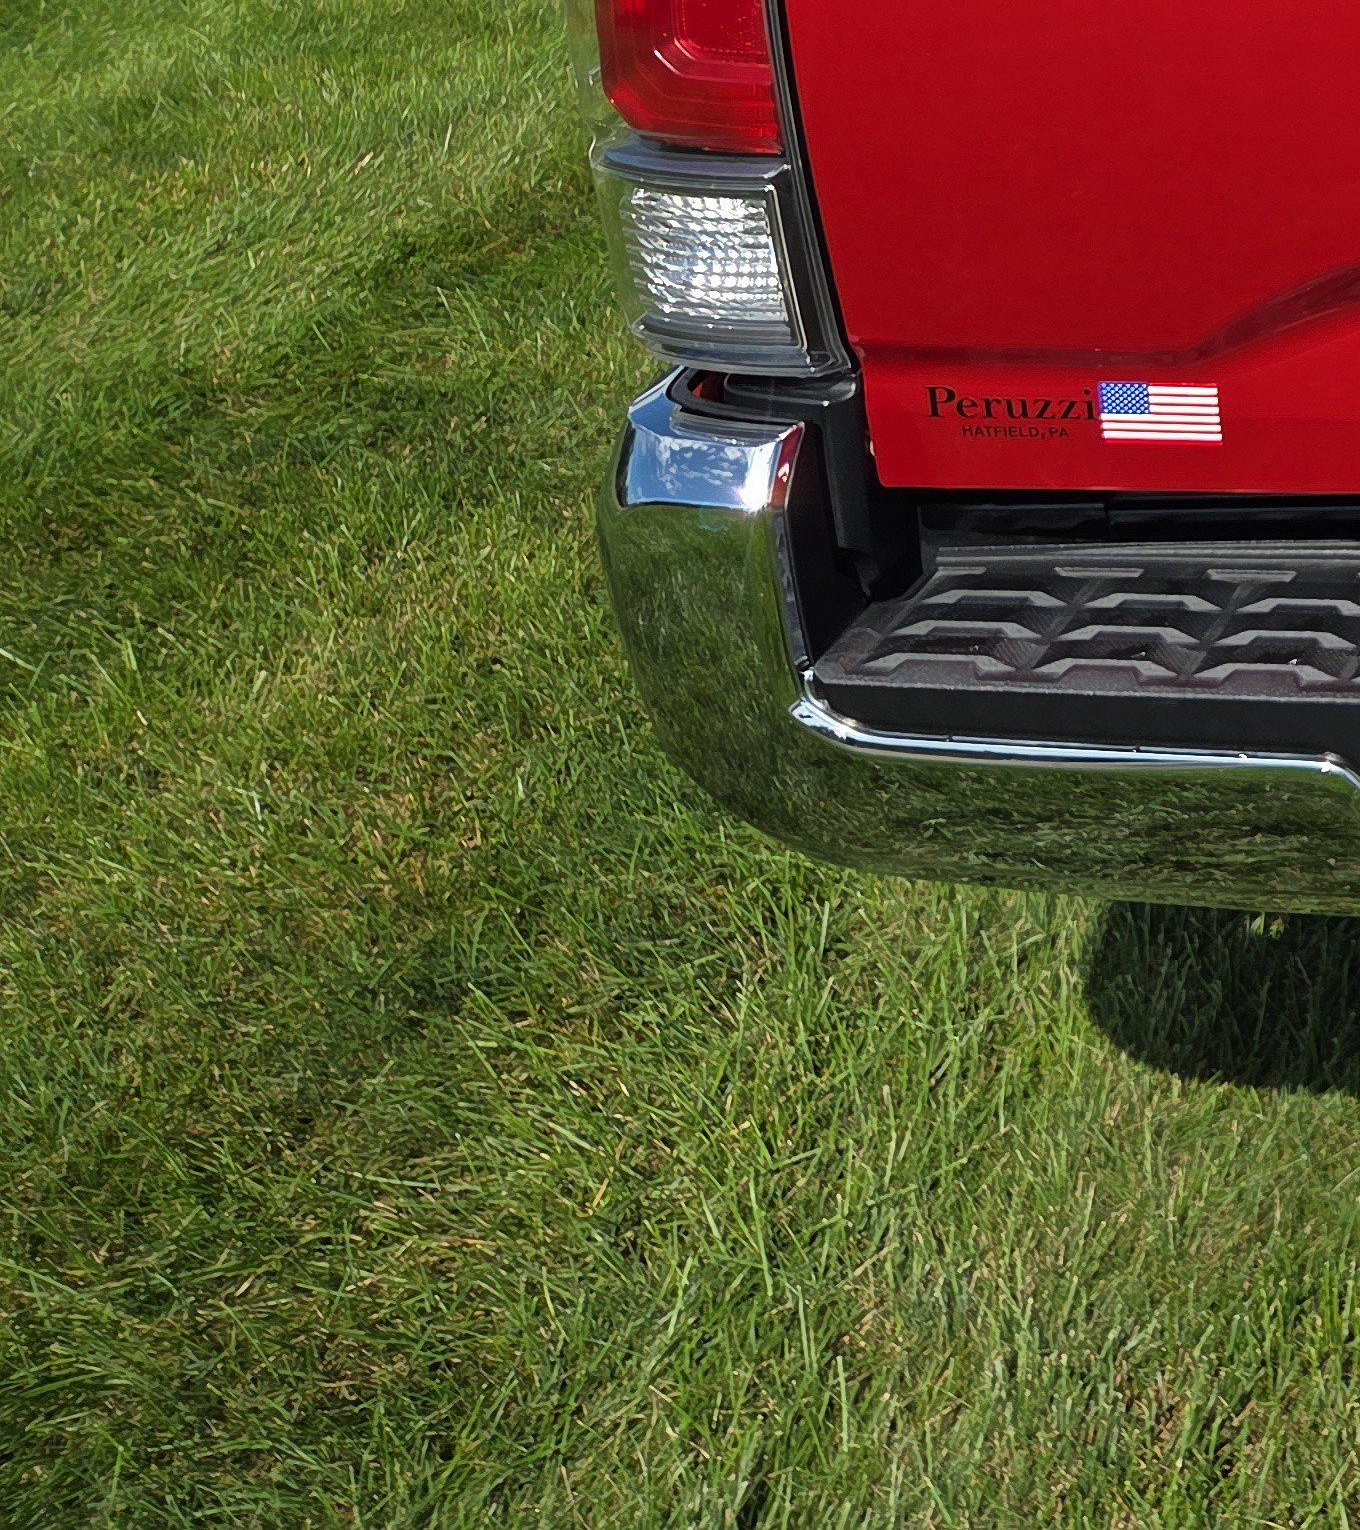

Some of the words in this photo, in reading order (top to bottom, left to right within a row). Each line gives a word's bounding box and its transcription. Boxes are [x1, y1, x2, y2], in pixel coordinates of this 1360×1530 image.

[925, 385, 1100, 421] Peruzzi
[961, 424, 1046, 439] HATFIELD,
[1049, 426, 1071, 439] PA
